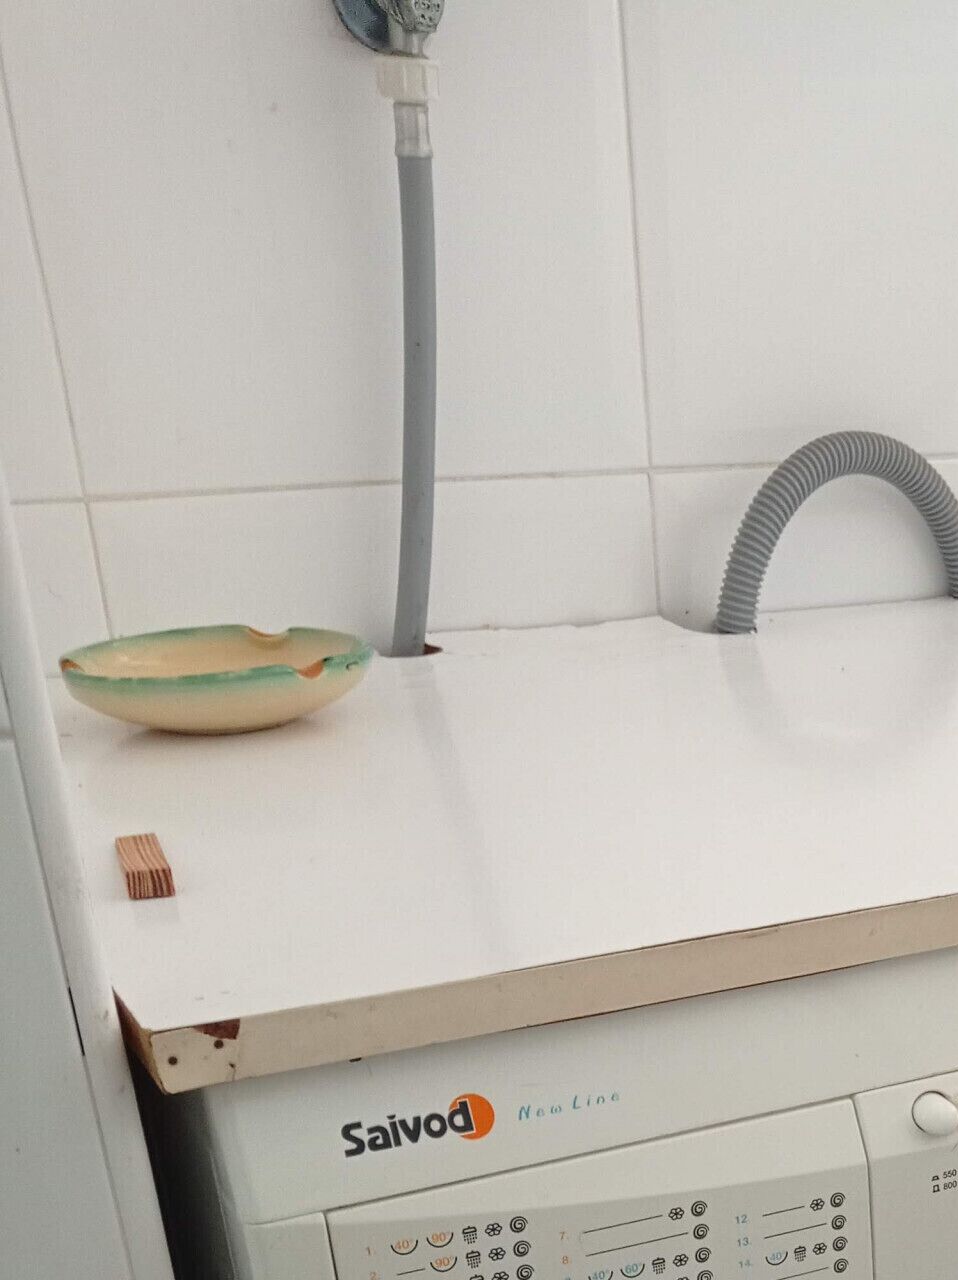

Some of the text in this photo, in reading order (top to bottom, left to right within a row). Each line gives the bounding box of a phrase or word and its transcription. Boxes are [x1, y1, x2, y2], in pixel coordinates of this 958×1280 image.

[518, 1092, 621, 1121] New Line
[341, 1098, 475, 1159] Saivod
[943, 1169, 958, 1180] 550
[943, 1180, 958, 1191] 800
